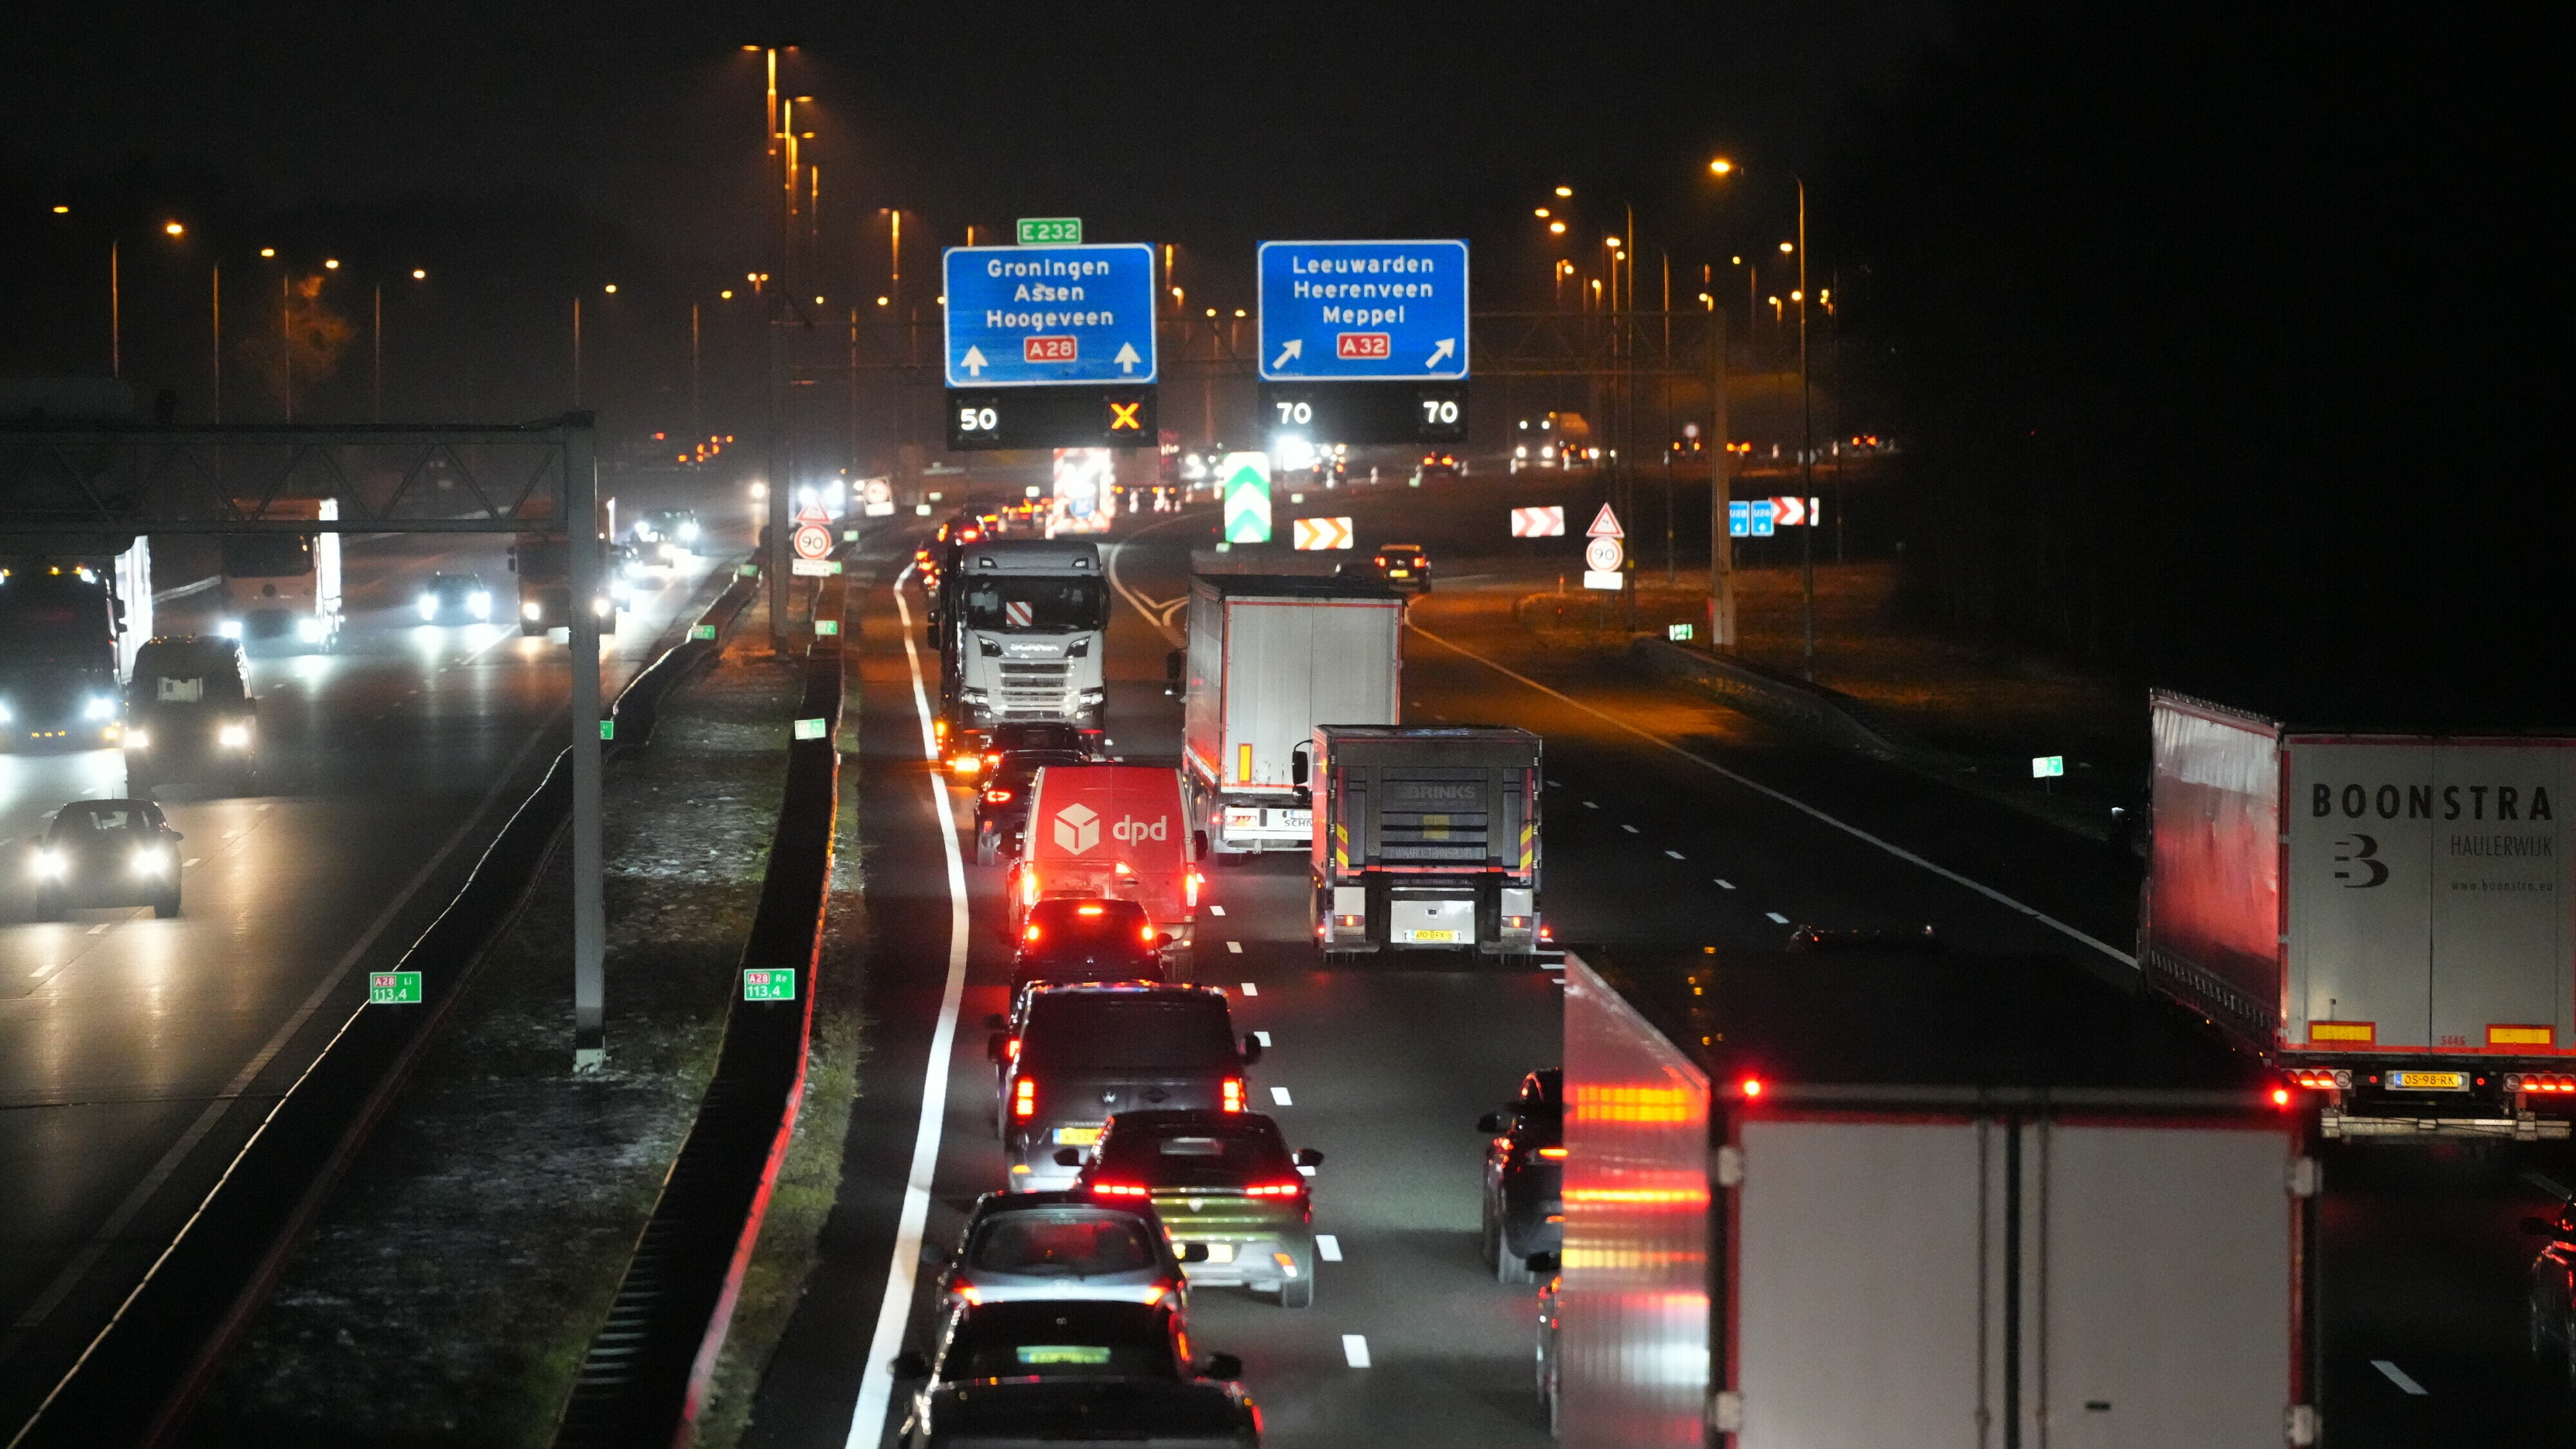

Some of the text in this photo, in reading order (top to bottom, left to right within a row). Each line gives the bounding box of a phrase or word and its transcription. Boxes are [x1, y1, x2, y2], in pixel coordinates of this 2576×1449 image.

[987, 259, 1110, 280] Groningen
[1293, 255, 1434, 274] Leeuwarden
[1014, 283, 1084, 302] Assen
[1294, 280, 1433, 298] Heerenveen
[986, 310, 1114, 332] Hoogeveen
[1323, 305, 1405, 327] Meppel
[960, 408, 997, 431] 50
[1276, 402, 1311, 424] 70
[1423, 401, 1458, 423] 70
[802, 536, 823, 549] 90
[1594, 547, 1615, 560] 90
[1406, 786, 1476, 799] BRINKS
[2312, 783, 2553, 821] BOONSTRA
[1112, 814, 1167, 847] dpd
[2450, 836, 2553, 857] HAULERWIJK
[375, 976, 412, 986] A28 Li
[749, 974, 787, 983] A28 Re
[374, 989, 407, 1001] 113,4
[747, 985, 781, 998] 113,4
[2404, 1074, 2455, 1085] OS-98-RK
